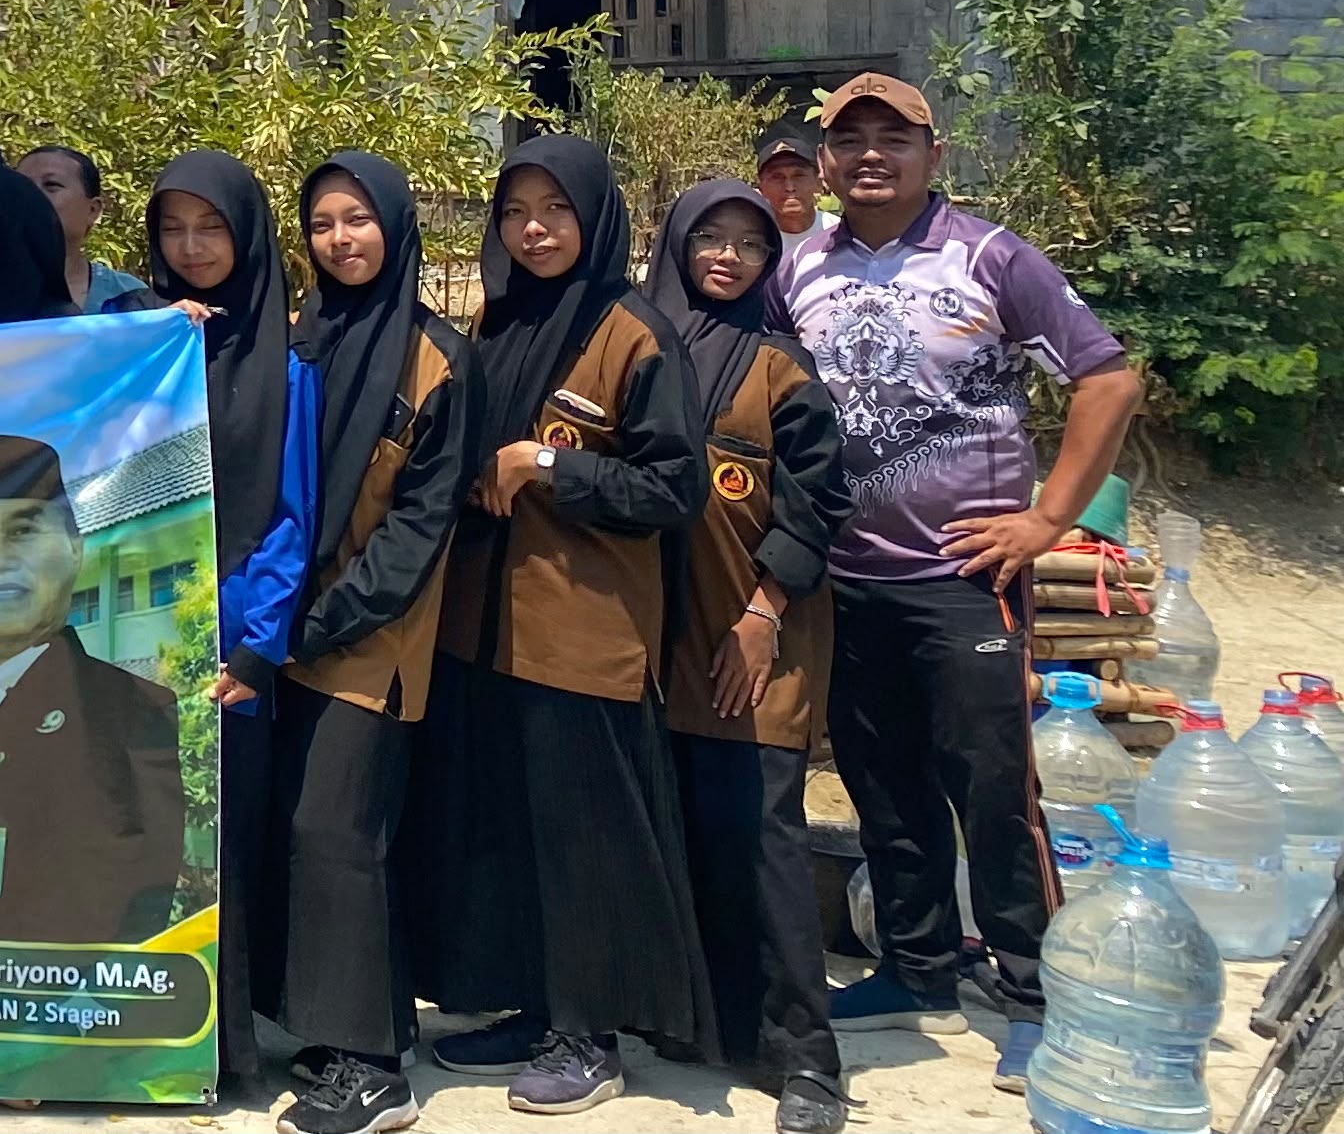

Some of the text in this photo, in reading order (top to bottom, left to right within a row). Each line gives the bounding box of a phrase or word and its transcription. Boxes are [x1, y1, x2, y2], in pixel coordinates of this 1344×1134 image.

[850, 77, 888, 95] alo
[95, 961, 175, 994] M.Ag.
[25, 1000, 39, 1022] 2
[45, 1003, 121, 1030] Sragen
